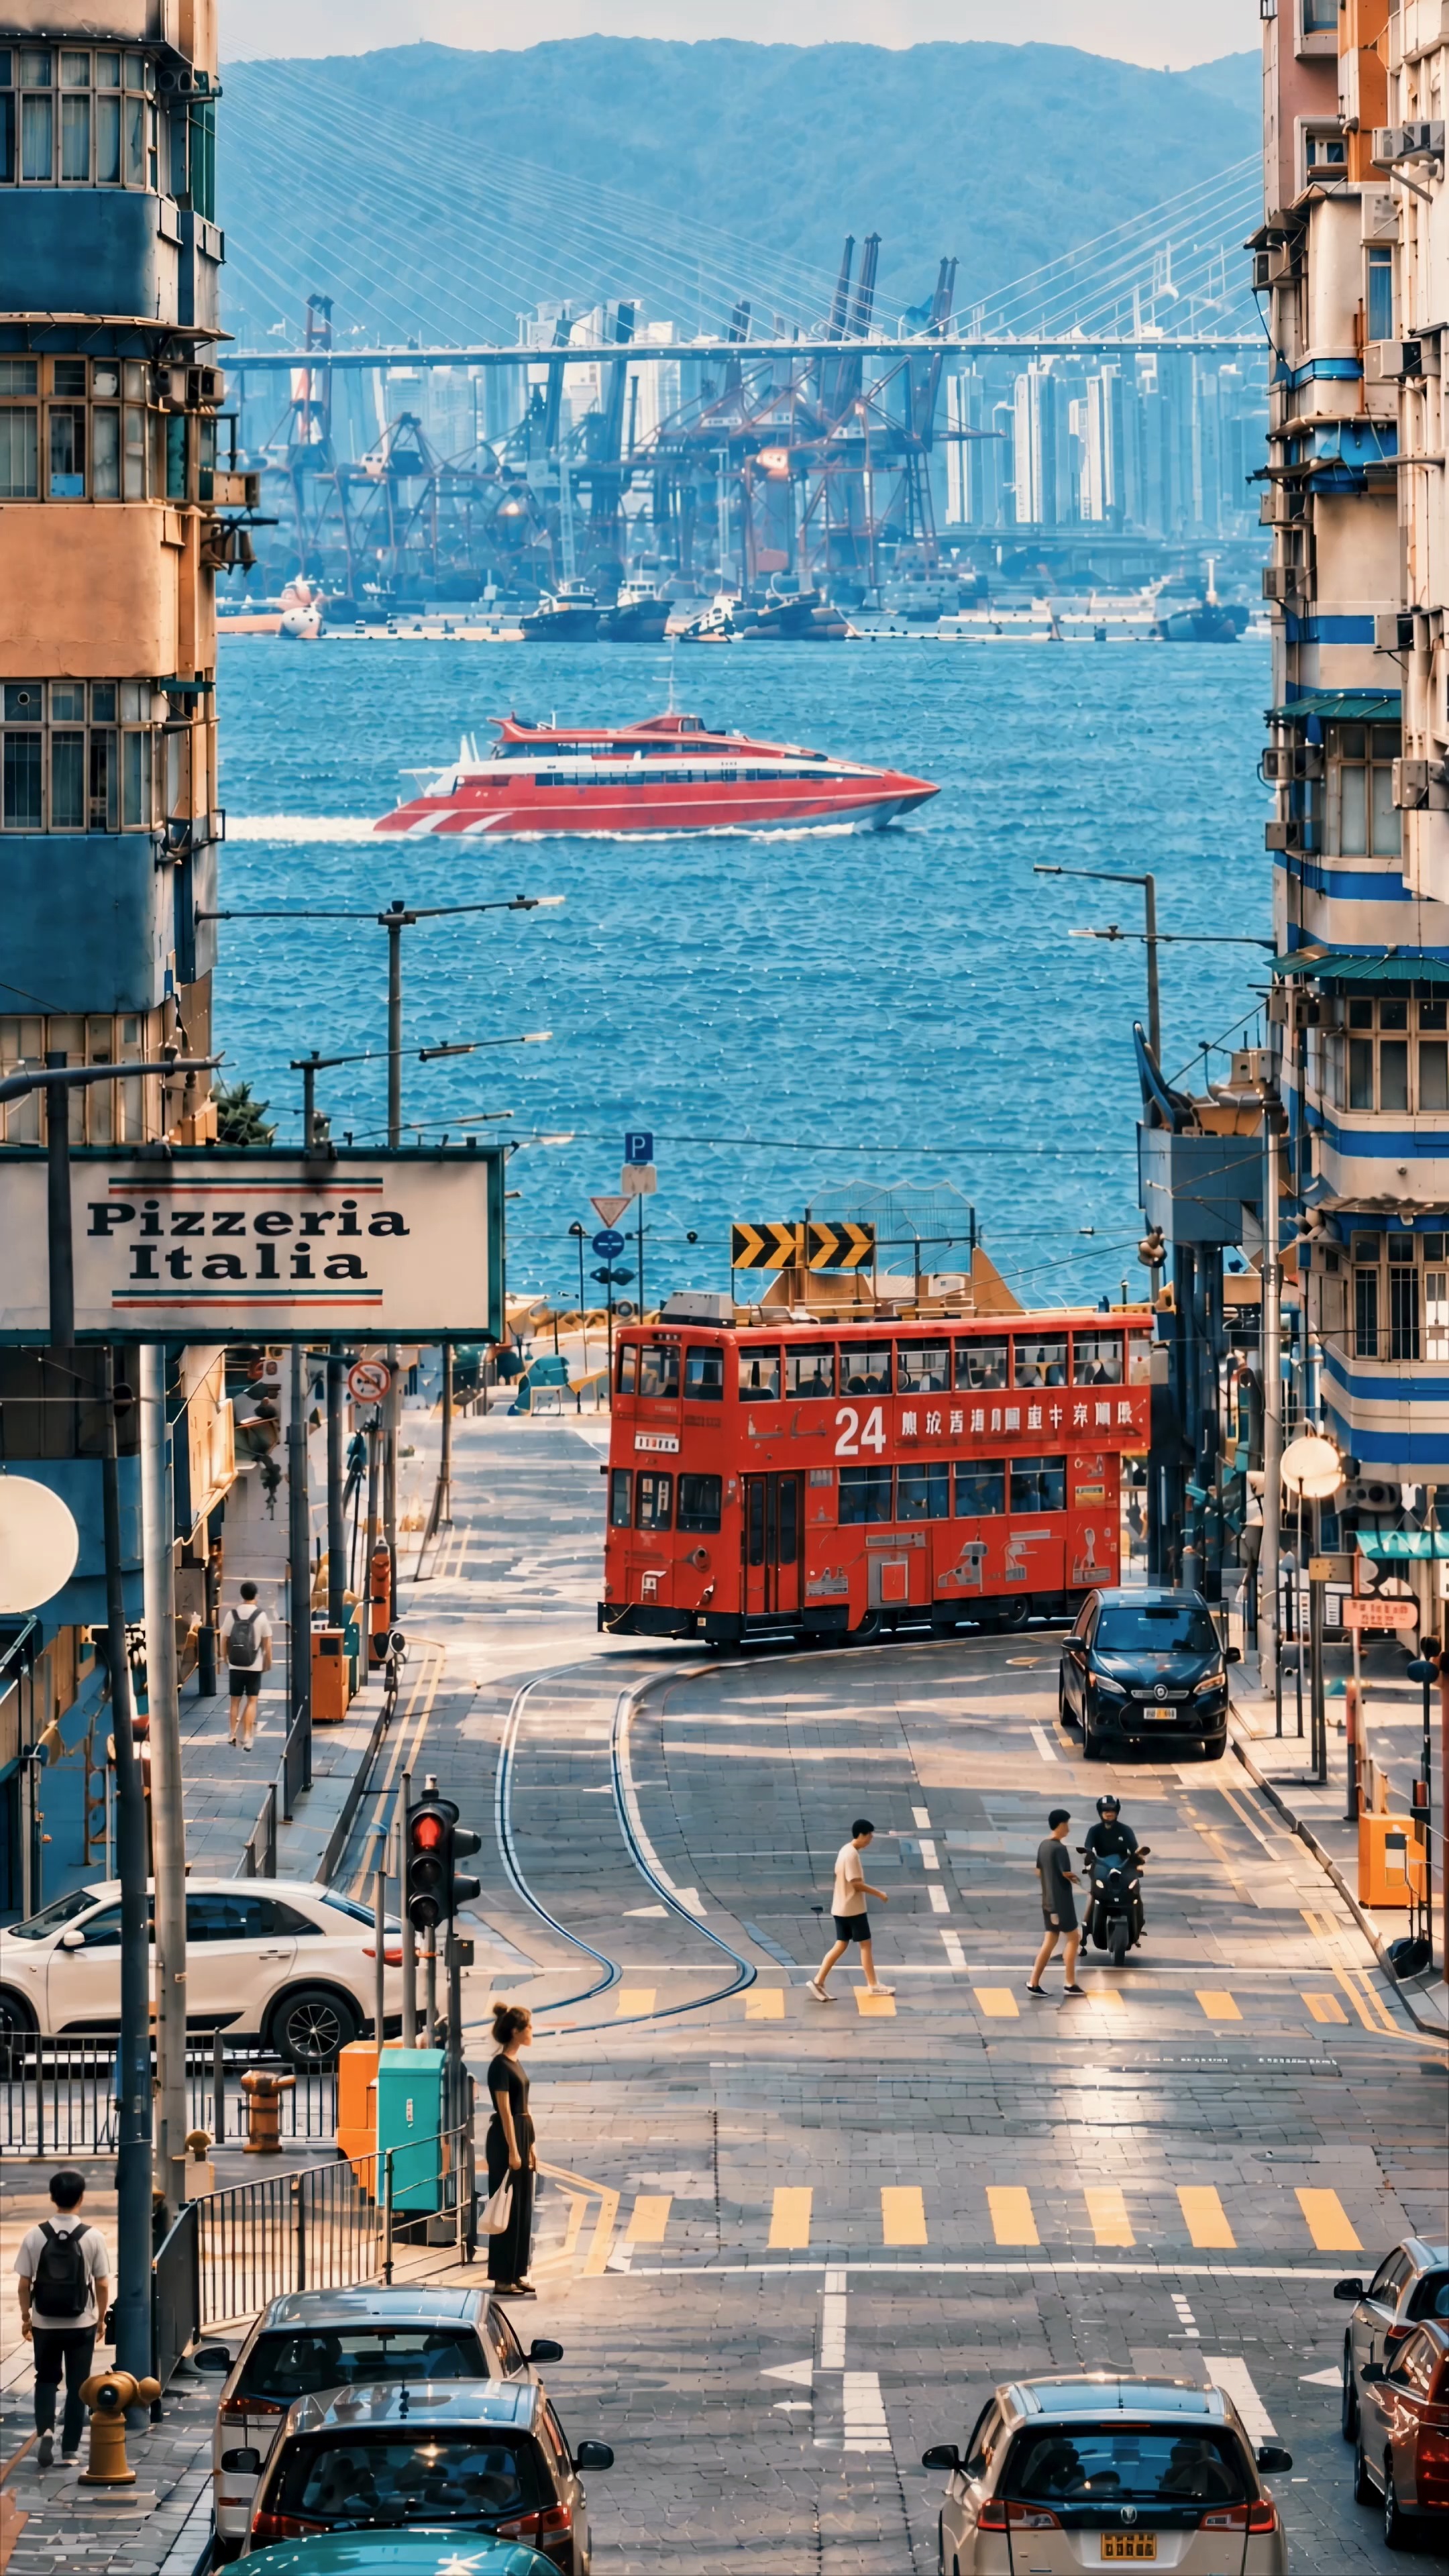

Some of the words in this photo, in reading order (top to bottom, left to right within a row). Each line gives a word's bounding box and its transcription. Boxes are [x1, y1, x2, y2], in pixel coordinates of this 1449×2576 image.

[632, 1136, 646, 1159] P
[87, 1199, 409, 1236] Pizzeria
[129, 1242, 368, 1279] Italia
[835, 1407, 885, 1455] 24
